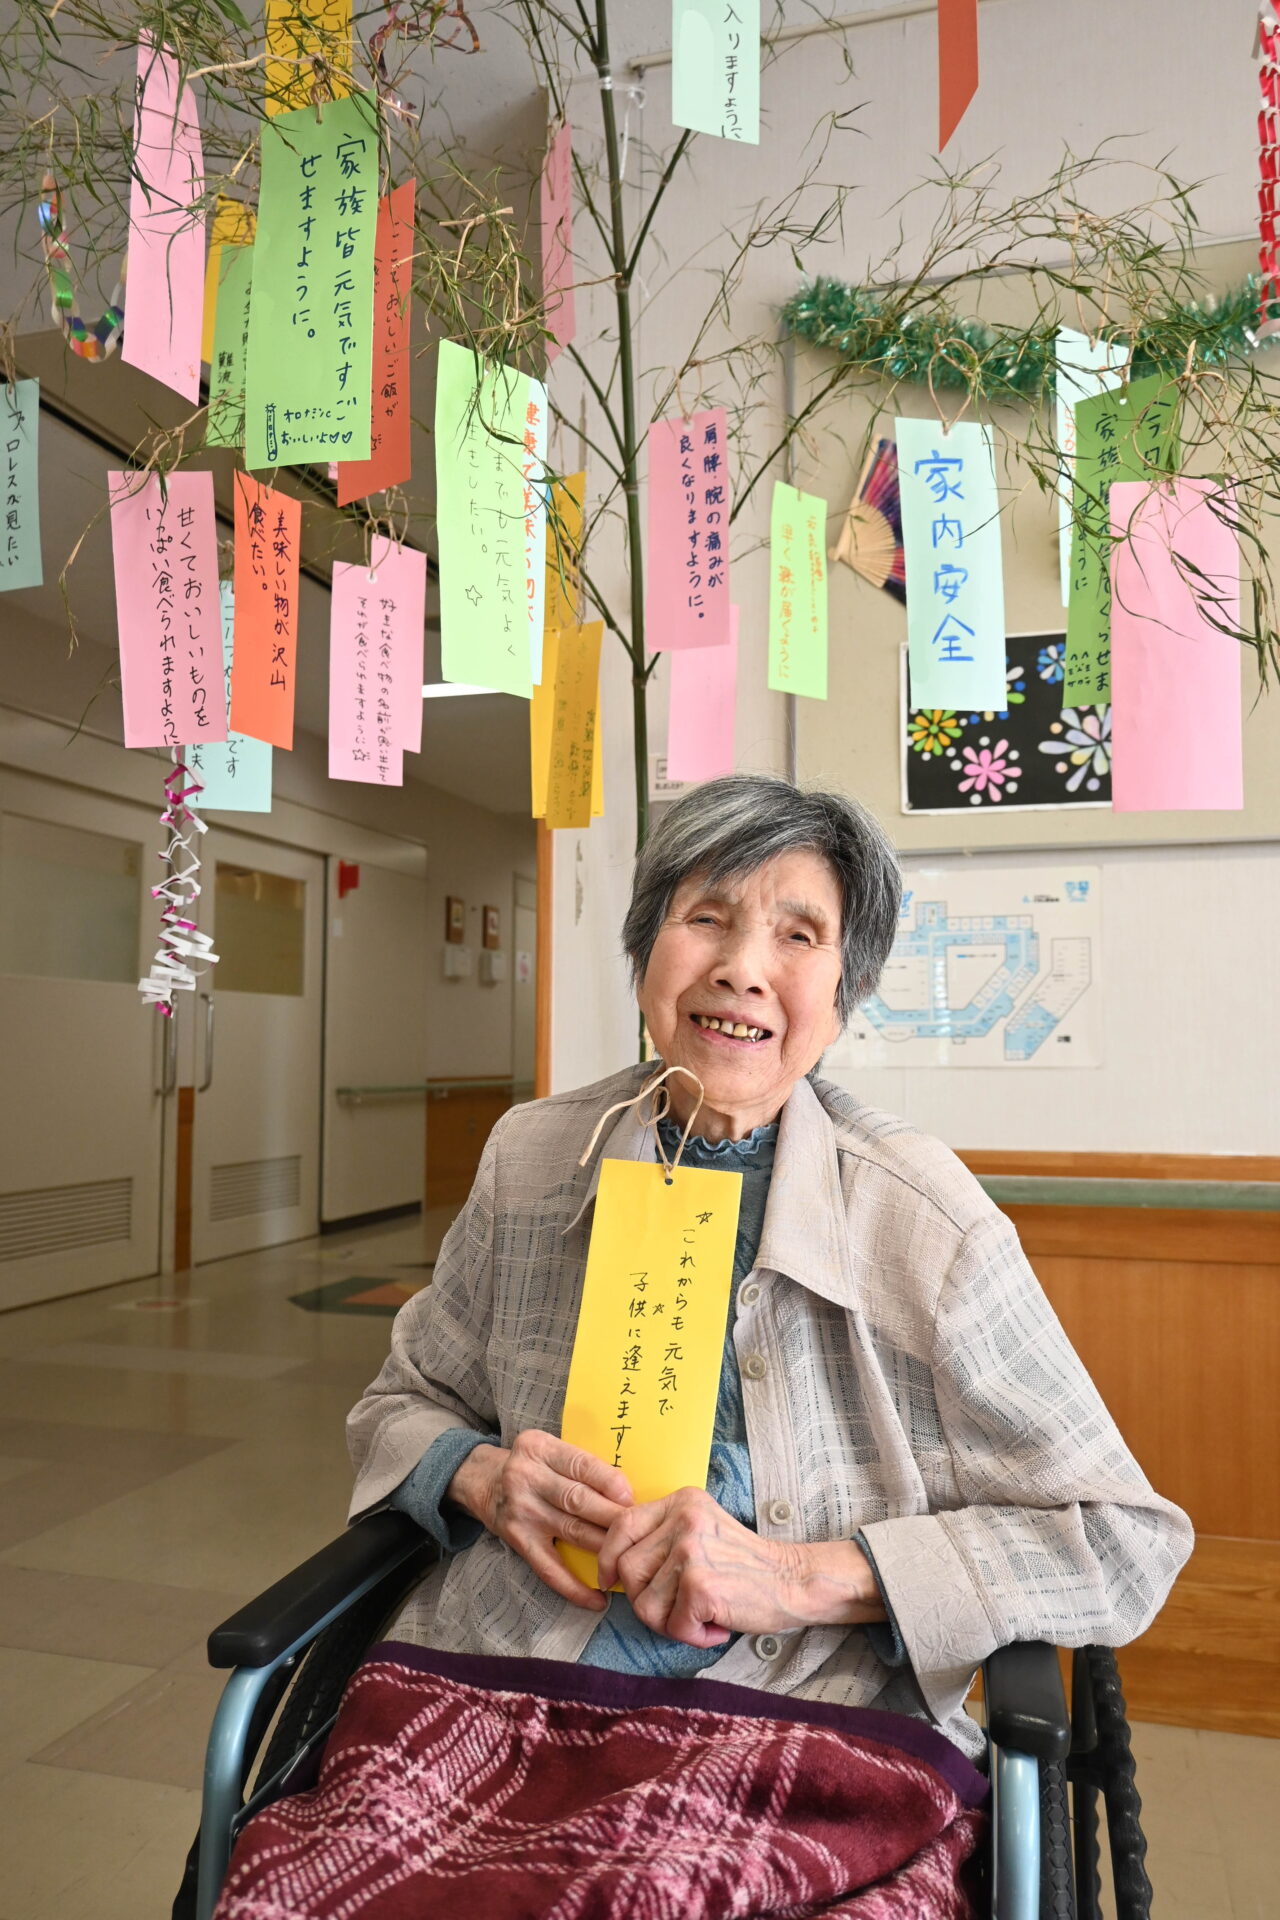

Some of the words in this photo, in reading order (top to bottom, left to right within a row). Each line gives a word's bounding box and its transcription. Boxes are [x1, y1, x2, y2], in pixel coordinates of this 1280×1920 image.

[722, 3, 743, 139] 入りますように
[292, 155, 322, 338] せますように。
[334, 133, 367, 421] 家族皆元気ですご
[250, 503, 267, 591] 食べたい。
[680, 435, 704, 619] 良くなりますように。
[704, 423, 725, 588] 肩・腰・腕の痛みが
[914, 449, 975, 662] 家内安全
[145, 508, 180, 745] いっぱい食べられますように
[177, 507, 209, 726] 甘くておいしいものを
